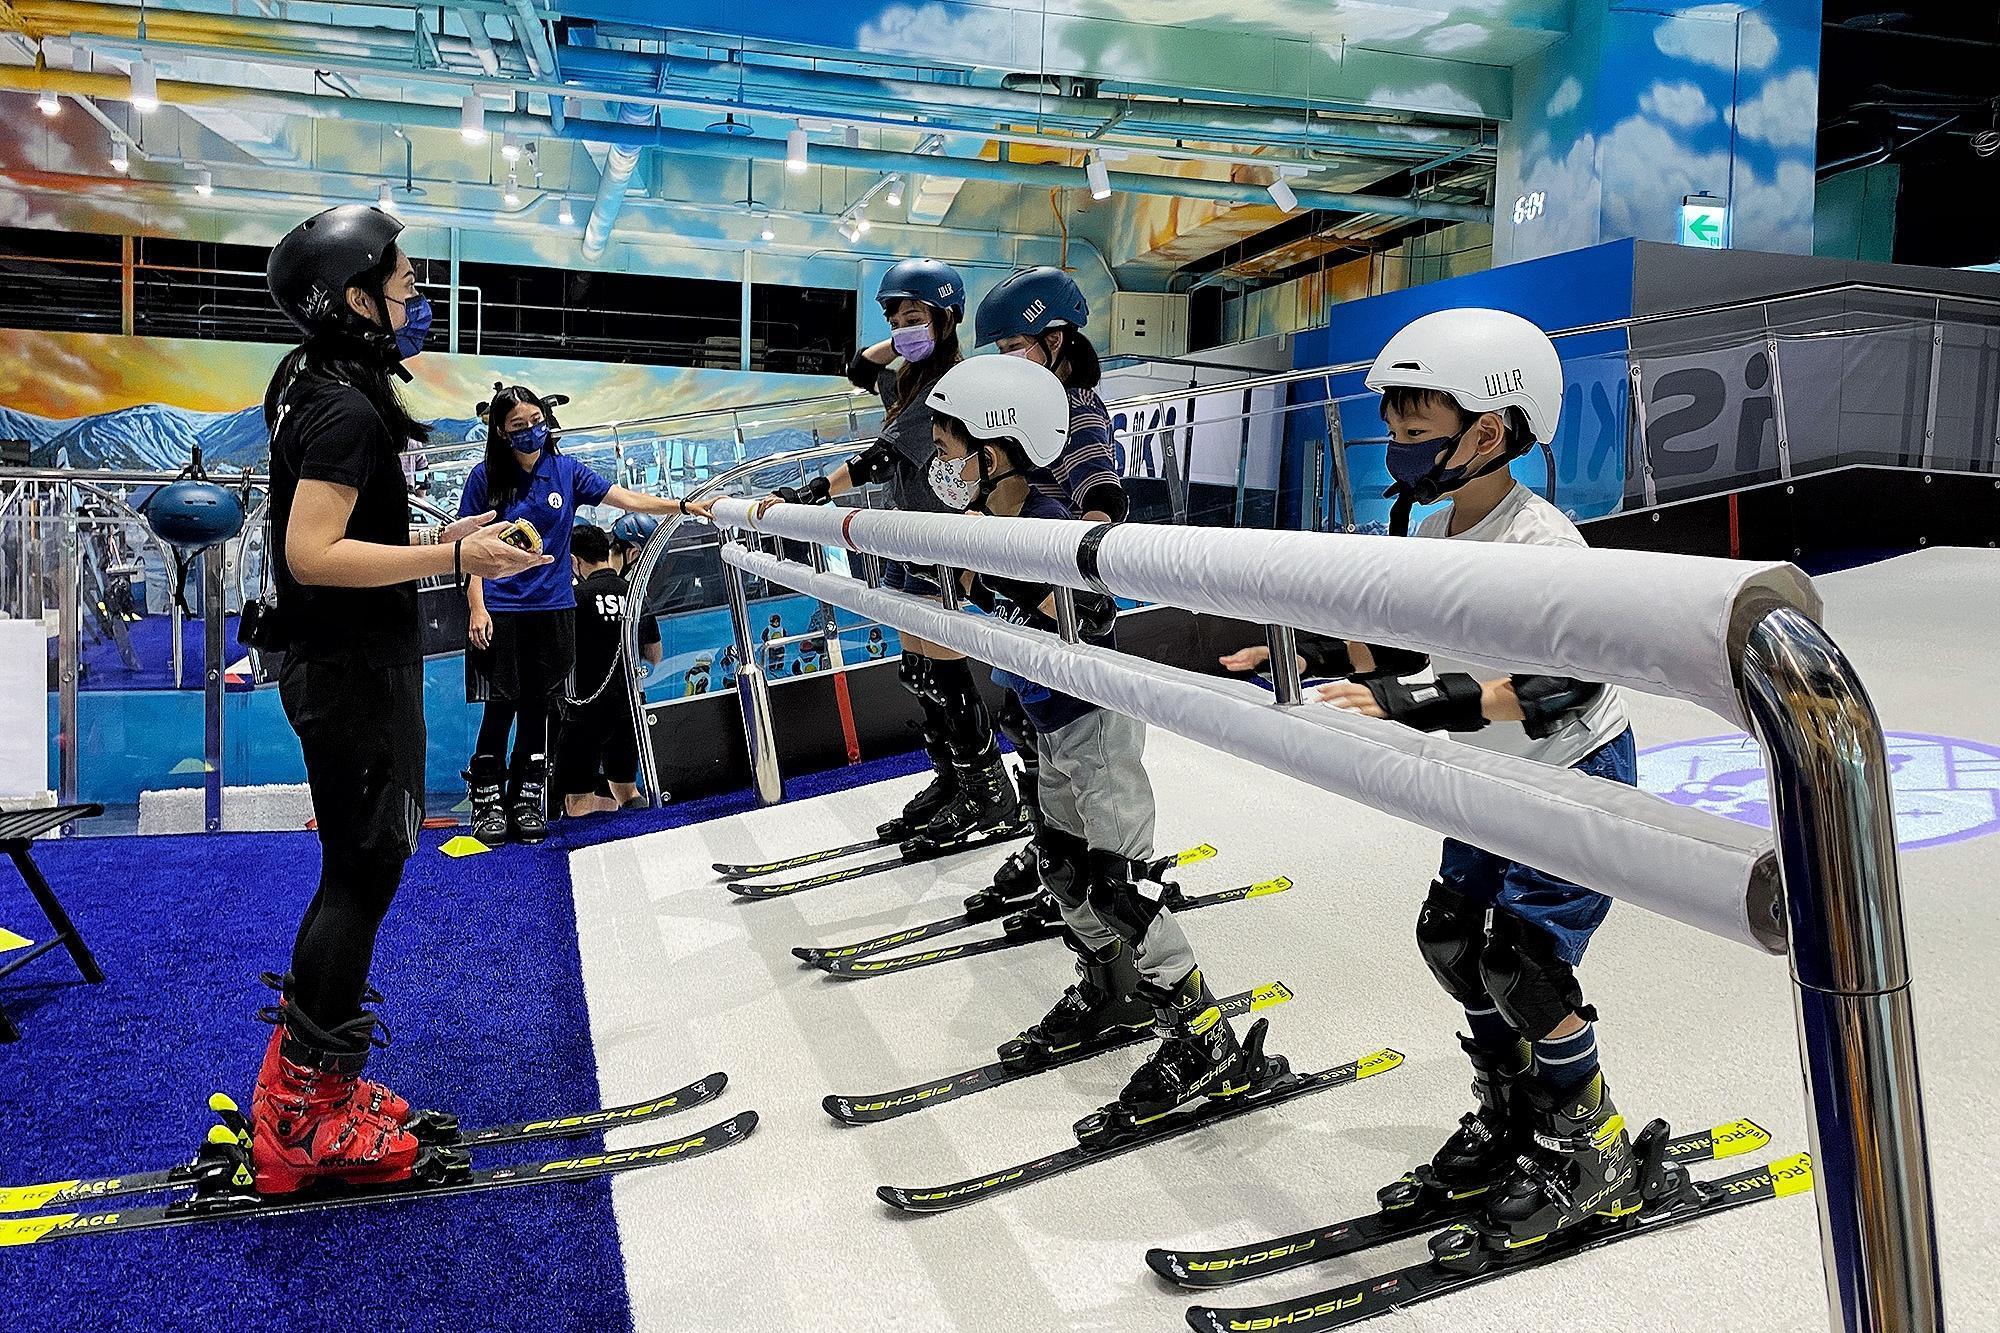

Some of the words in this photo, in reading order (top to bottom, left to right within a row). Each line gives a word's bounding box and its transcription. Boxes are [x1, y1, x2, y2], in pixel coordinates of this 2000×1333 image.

[937, 282, 954, 299] ULLR
[1022, 299, 1047, 324] ULLR
[1484, 368, 1524, 397] ULLR
[985, 407, 1017, 428] ULLR
[746, 848, 842, 873] FISCHER
[763, 867, 865, 892] FISCHER
[825, 927, 928, 957] FISCHER
[851, 946, 964, 971] FISCHER
[1175, 1053, 1237, 1104] FISCHER
[854, 1083, 953, 1112] FISCHER
[523, 1097, 677, 1132] FISCHER
[540, 1136, 706, 1173] FISCHER
[1665, 1137, 1711, 1156] RACE
[912, 1169, 1024, 1201] FISCHER
[1556, 1167, 1632, 1230] FSCHER
[1722, 1174, 1771, 1195] RACE
[1188, 1238, 1316, 1271] FISCHER
[1230, 1292, 1363, 1331] FISCHER
